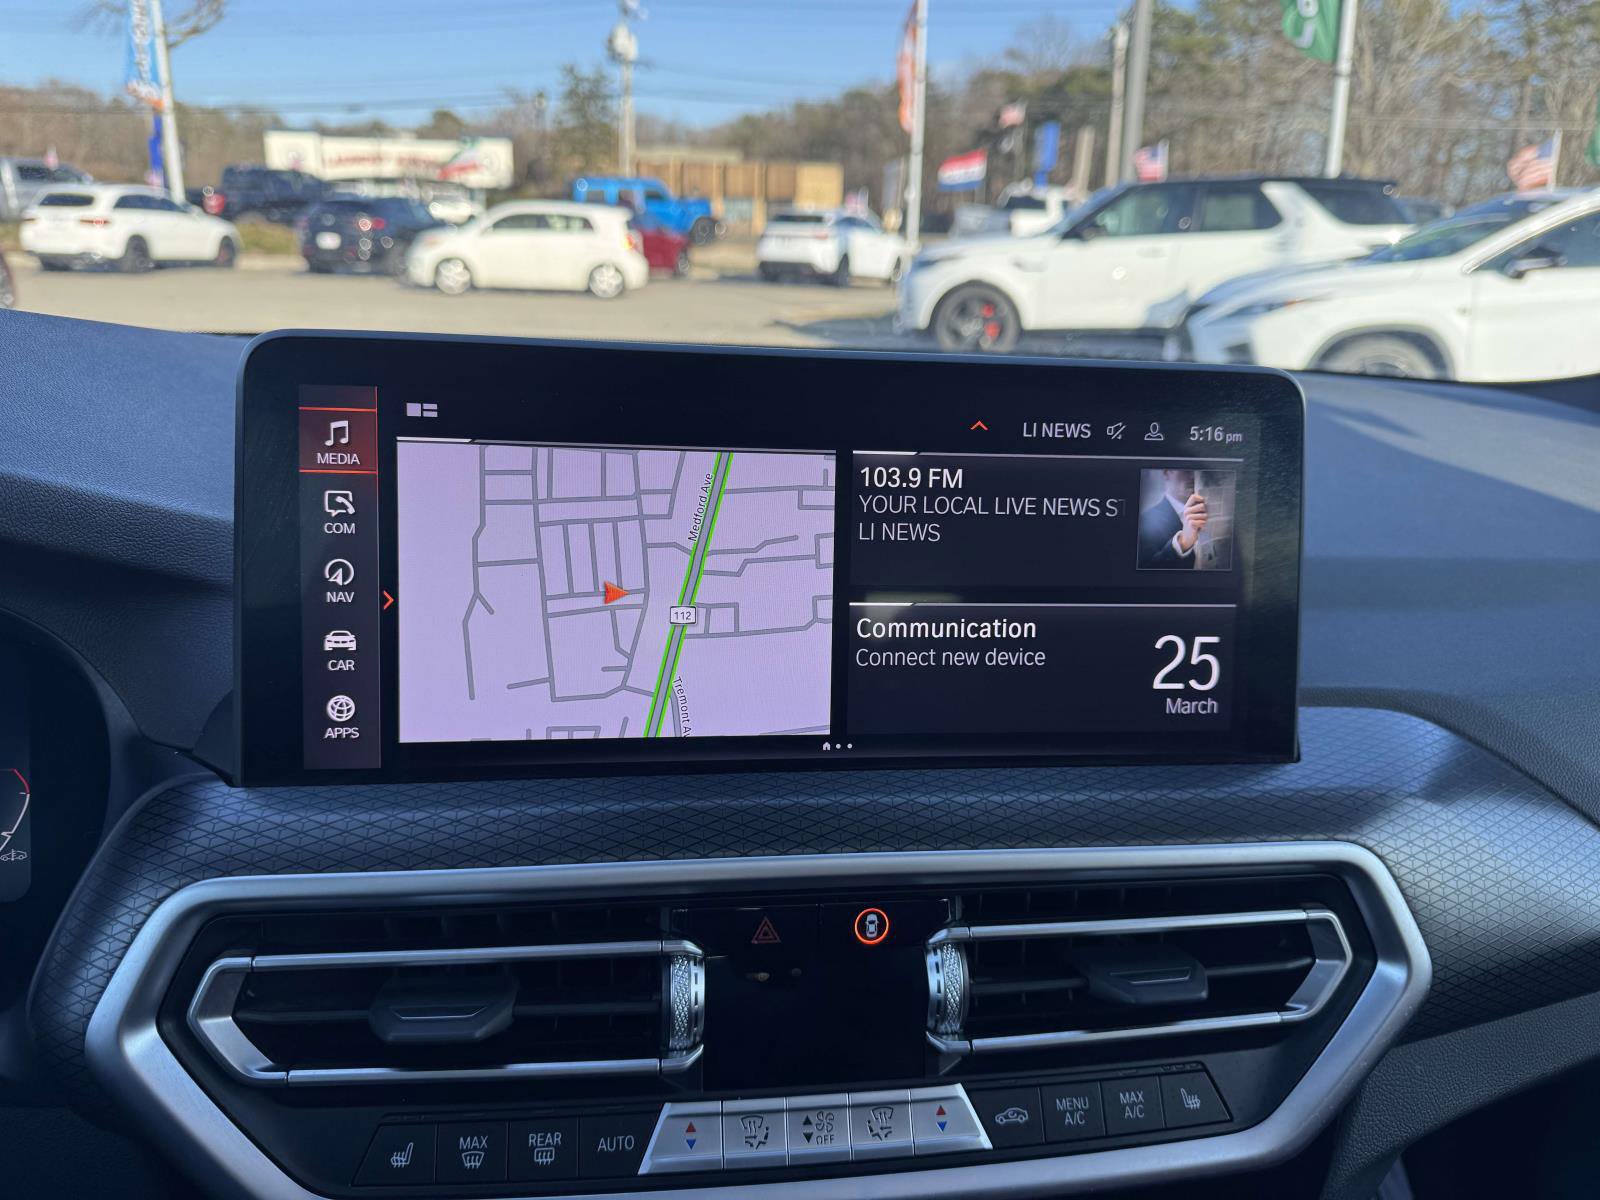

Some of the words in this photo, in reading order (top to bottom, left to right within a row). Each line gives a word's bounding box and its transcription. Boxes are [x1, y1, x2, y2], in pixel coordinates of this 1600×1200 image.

[1022, 422, 1037, 438] LI
[1041, 422, 1092, 439] NEWS
[1189, 425, 1224, 442] 5:16
[1225, 433, 1243, 444] pm
[316, 452, 361, 465] MEDIA
[860, 466, 922, 489] 103.9
[928, 468, 964, 489] FM
[688, 495, 708, 542] Medford
[701, 473, 713, 494] Ave
[859, 495, 917, 514] YOUR
[923, 496, 989, 515] LOCAL
[995, 497, 1037, 515] LIVE
[1042, 498, 1101, 517] NEWS
[323, 522, 356, 534] COM
[859, 522, 875, 541] LI
[882, 522, 941, 542] NEWS
[326, 591, 355, 603] NAV
[673, 611, 692, 621] 112
[856, 617, 1036, 639] Communication
[855, 648, 936, 667] Connect
[942, 651, 979, 667] new
[984, 647, 1046, 667] device
[1152, 634, 1220, 691] 25
[327, 659, 355, 671] CAR
[673, 675, 690, 723] Tremont
[1165, 697, 1218, 715] March
[324, 727, 360, 739] APPS
[1056, 1096, 1089, 1111] MENU
[1120, 1091, 1145, 1105] MAX
[1064, 1111, 1085, 1125] A/C
[1124, 1106, 1145, 1119] A/C
[459, 1135, 489, 1150] MAX
[528, 1132, 562, 1147] REAR
[597, 1135, 635, 1152] AUTO
[815, 1134, 835, 1145] OFF
